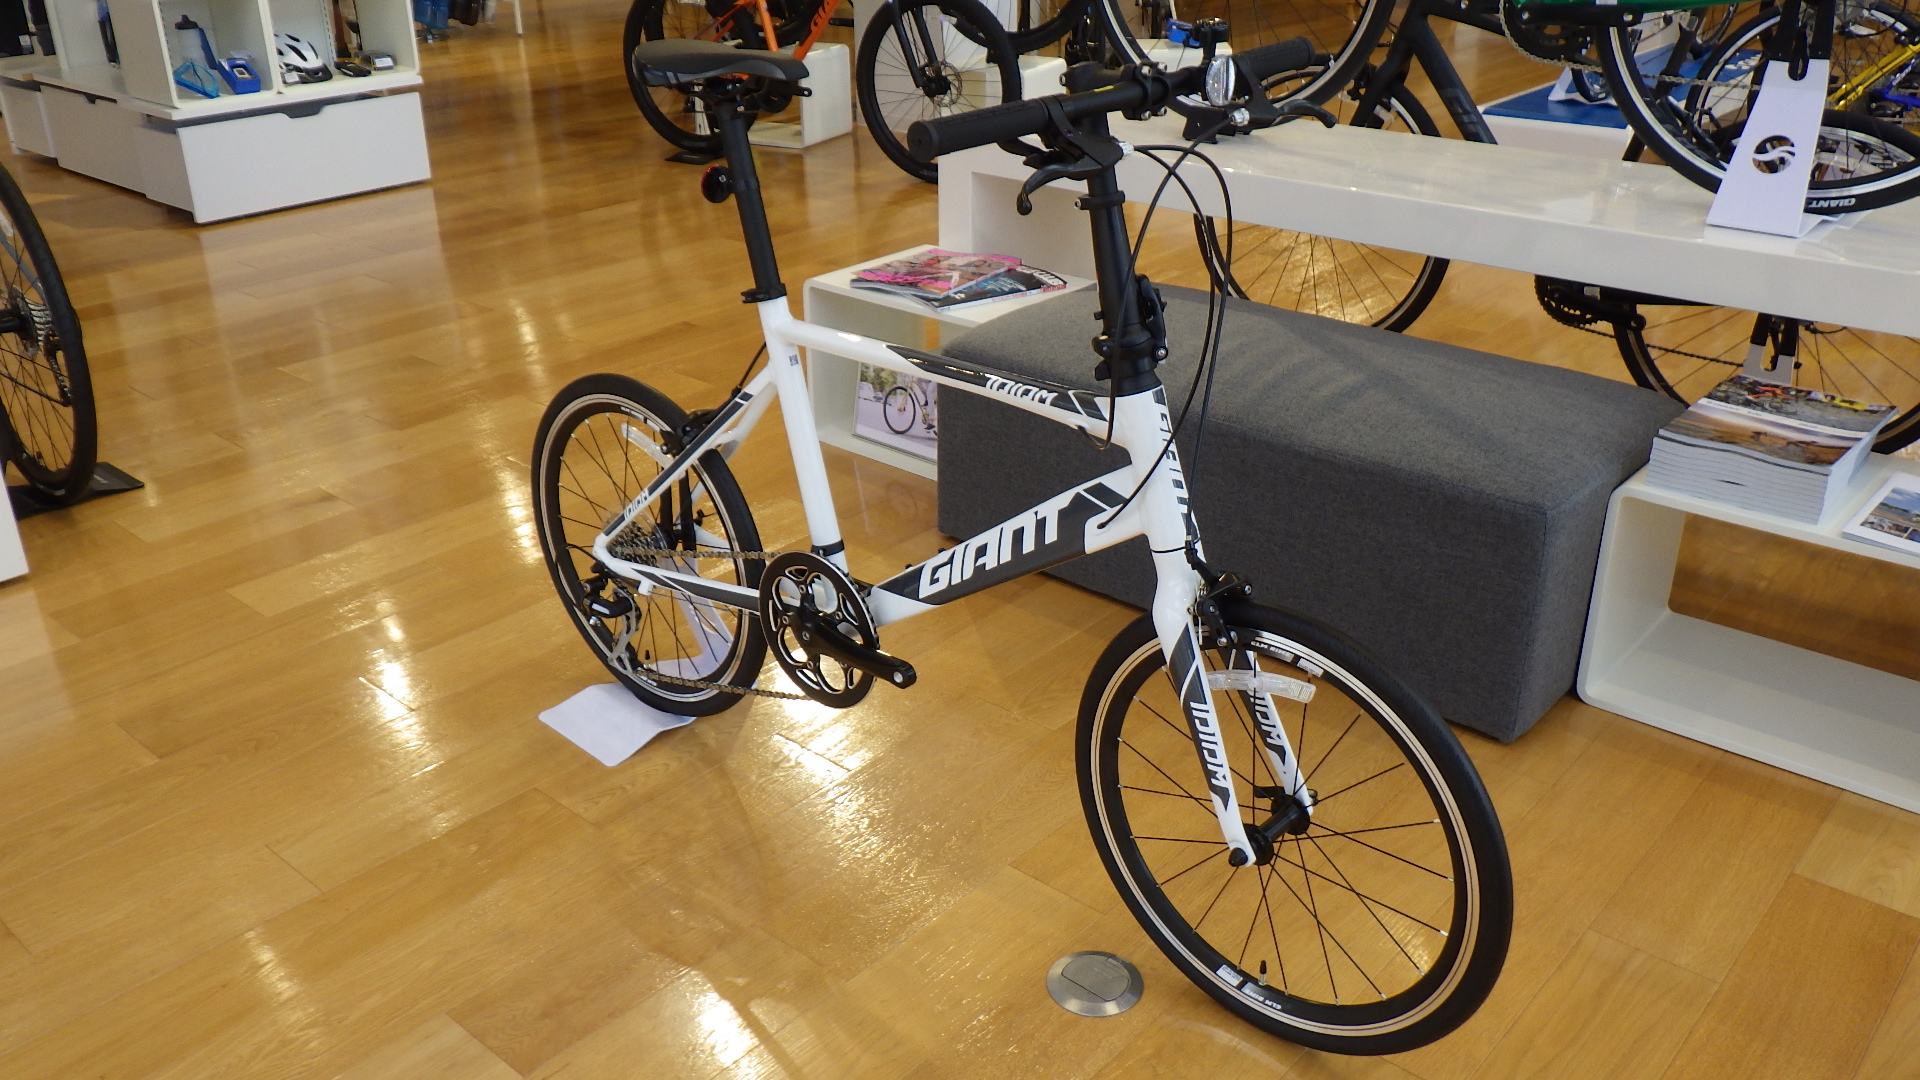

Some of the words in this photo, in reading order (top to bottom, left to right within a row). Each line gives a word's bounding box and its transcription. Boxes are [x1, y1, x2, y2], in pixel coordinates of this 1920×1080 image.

[1808, 198, 1856, 208] GIANT
[985, 373, 1059, 406] IDIOM
[918, 500, 1069, 600] GIANT
[1189, 701, 1231, 789] IDIOM
